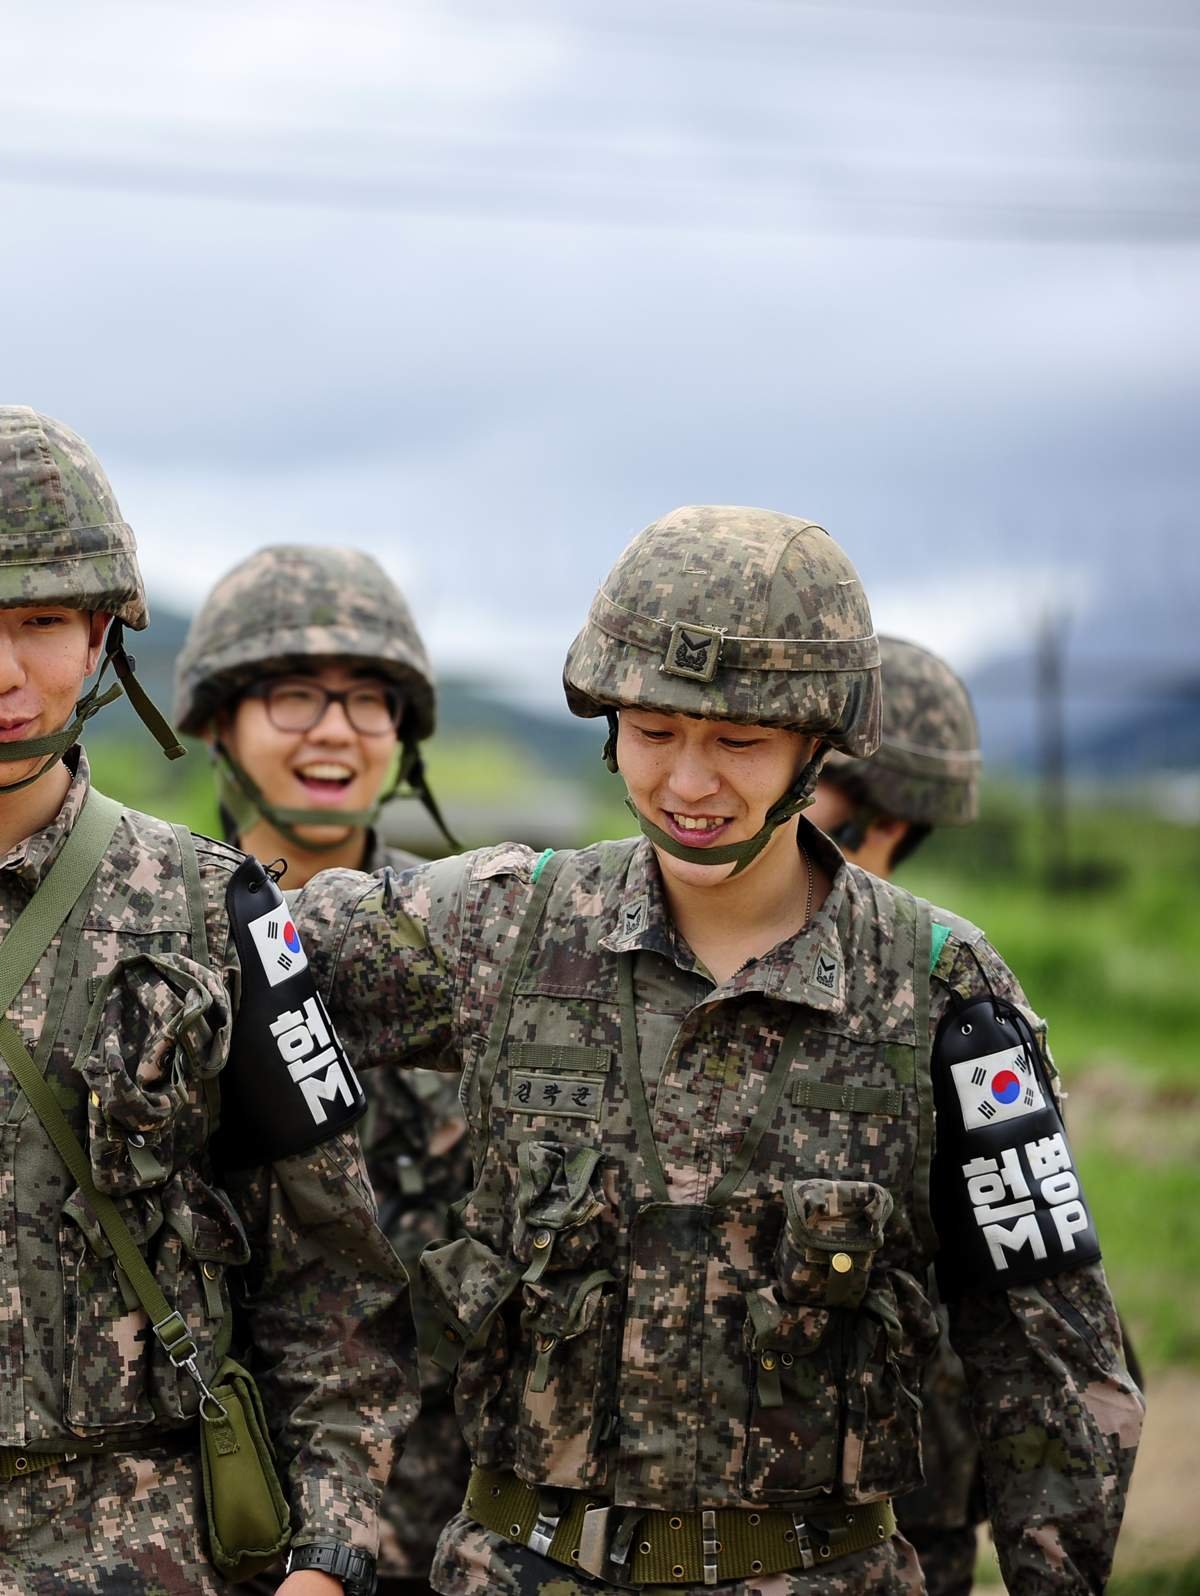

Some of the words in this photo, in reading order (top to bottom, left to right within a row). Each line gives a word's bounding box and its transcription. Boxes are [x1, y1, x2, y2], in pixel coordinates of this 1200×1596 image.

[269, 990, 343, 1083] 헌
[299, 1050, 363, 1126] M
[962, 1132, 1079, 1226] 헌병
[982, 1200, 1089, 1271] MP
